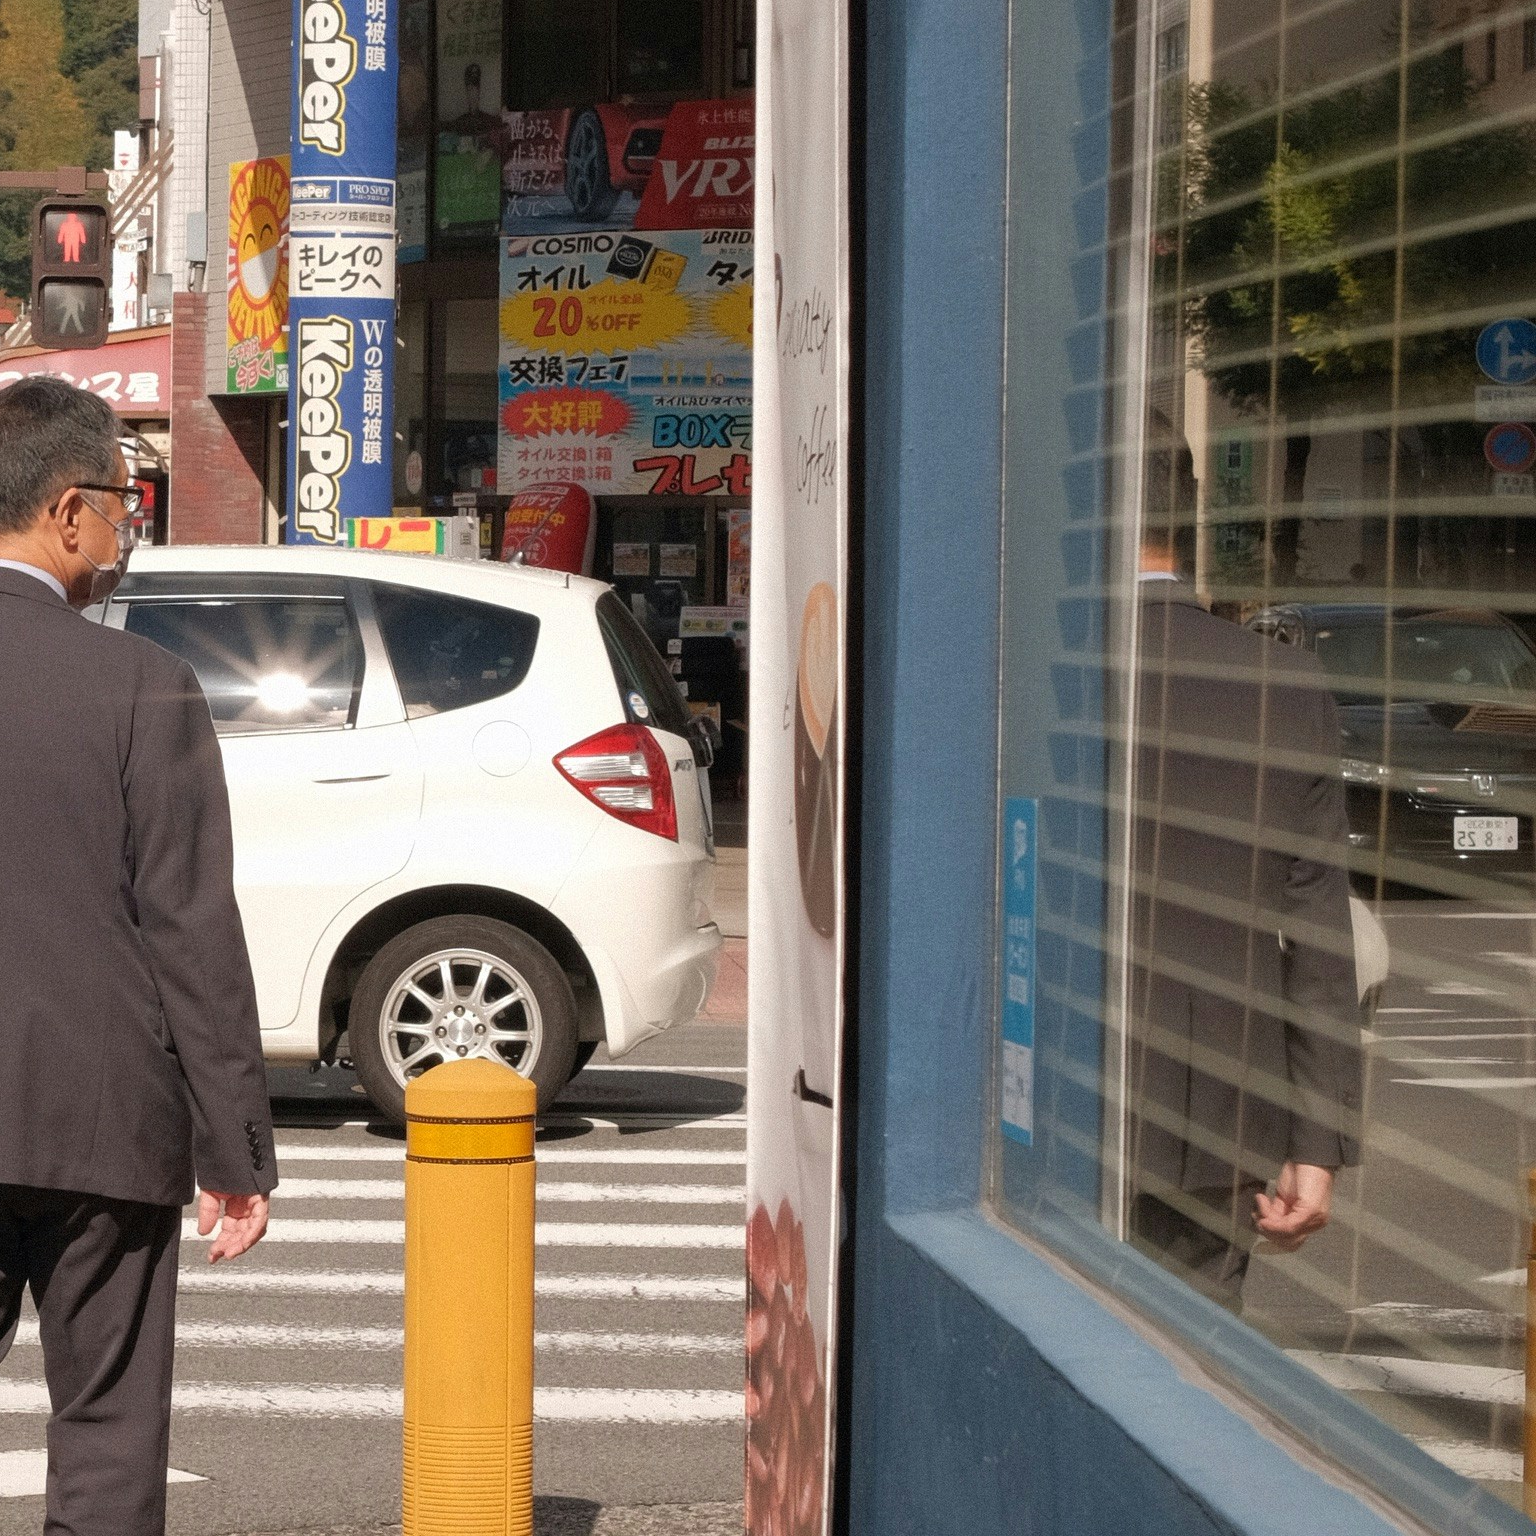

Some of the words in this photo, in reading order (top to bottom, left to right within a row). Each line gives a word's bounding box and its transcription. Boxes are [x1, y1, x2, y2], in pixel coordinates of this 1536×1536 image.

[349, 183, 369, 195] PRO
[299, 245, 383, 267] キレイの
[532, 235, 613, 255] COSMO
[299, 269, 382, 292] ピークへ
[517, 264, 591, 291] オイル
[360, 319, 386, 464] Wの透明被膜
[523, 400, 603, 428] 大好評
[296, 315, 353, 544] KeePer
